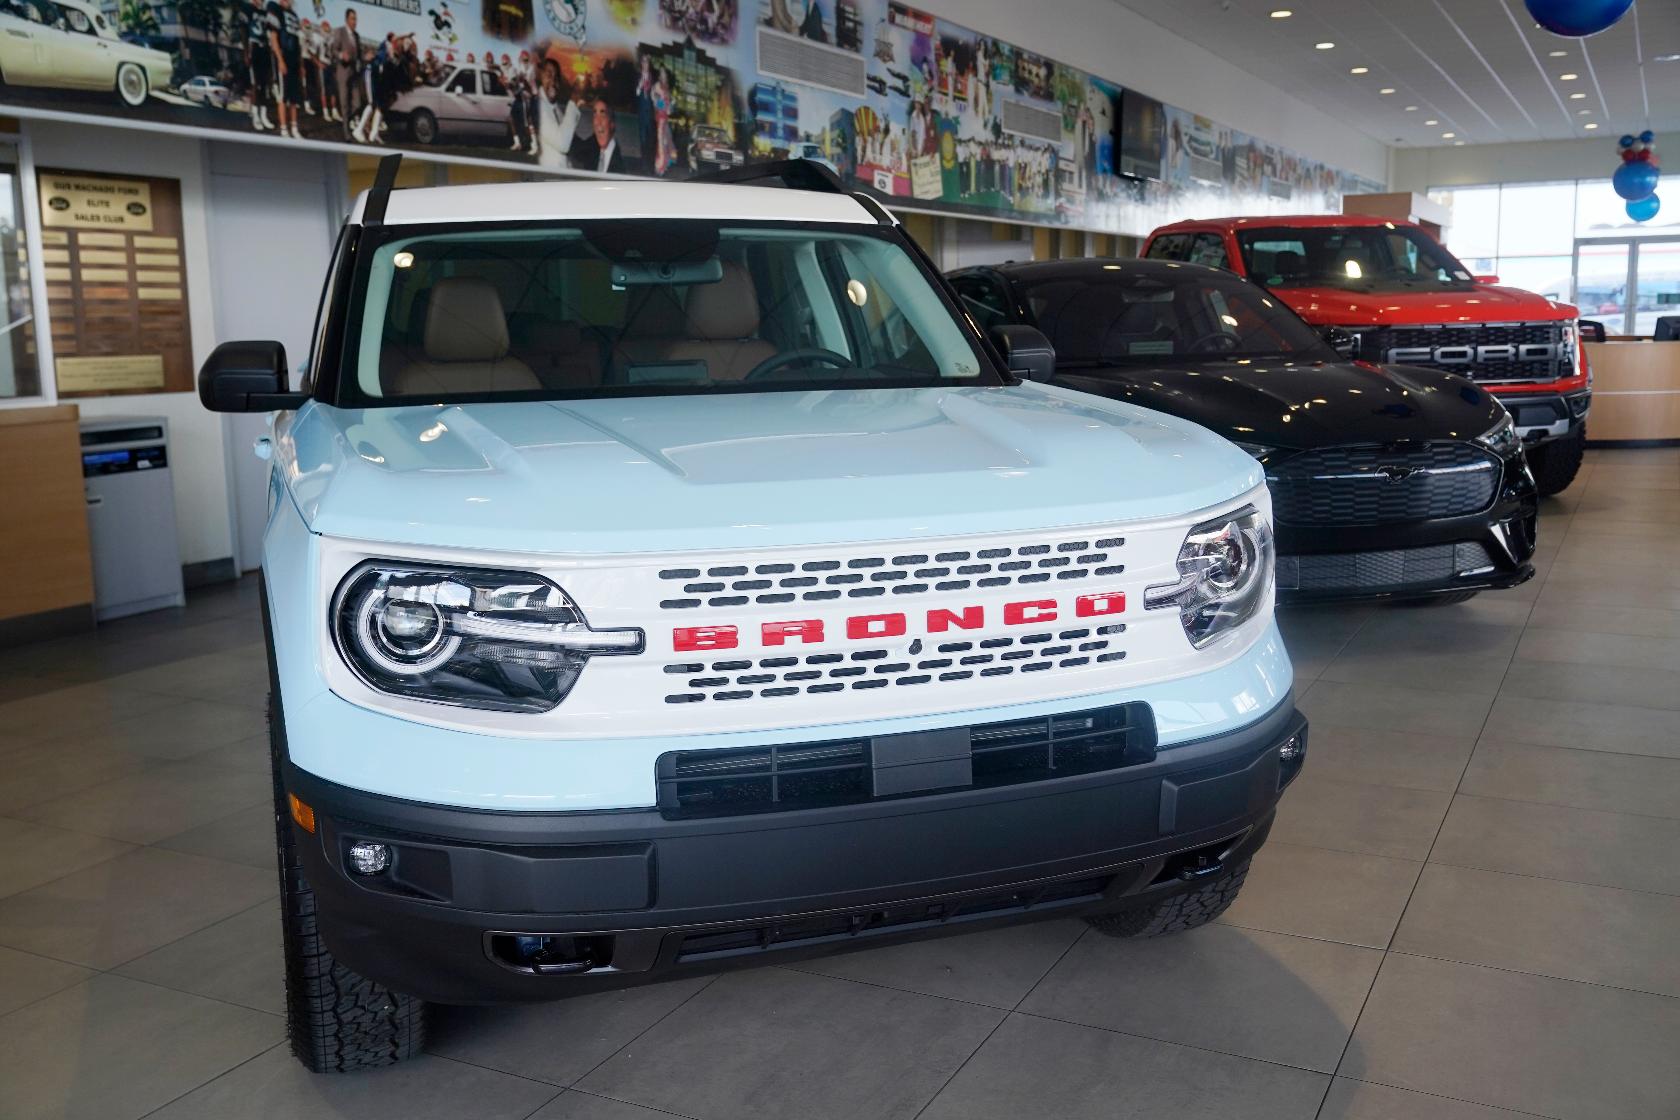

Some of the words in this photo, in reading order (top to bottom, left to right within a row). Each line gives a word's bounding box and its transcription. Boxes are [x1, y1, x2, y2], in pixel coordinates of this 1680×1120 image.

[74, 183, 115, 193] MACHADO
[117, 187, 139, 195] FORD
[87, 199, 110, 208] ELITE
[74, 213, 100, 222] SALES
[103, 214, 125, 223] CLUB
[1387, 344, 1554, 364] FORD
[673, 591, 1127, 652] BRONCO
